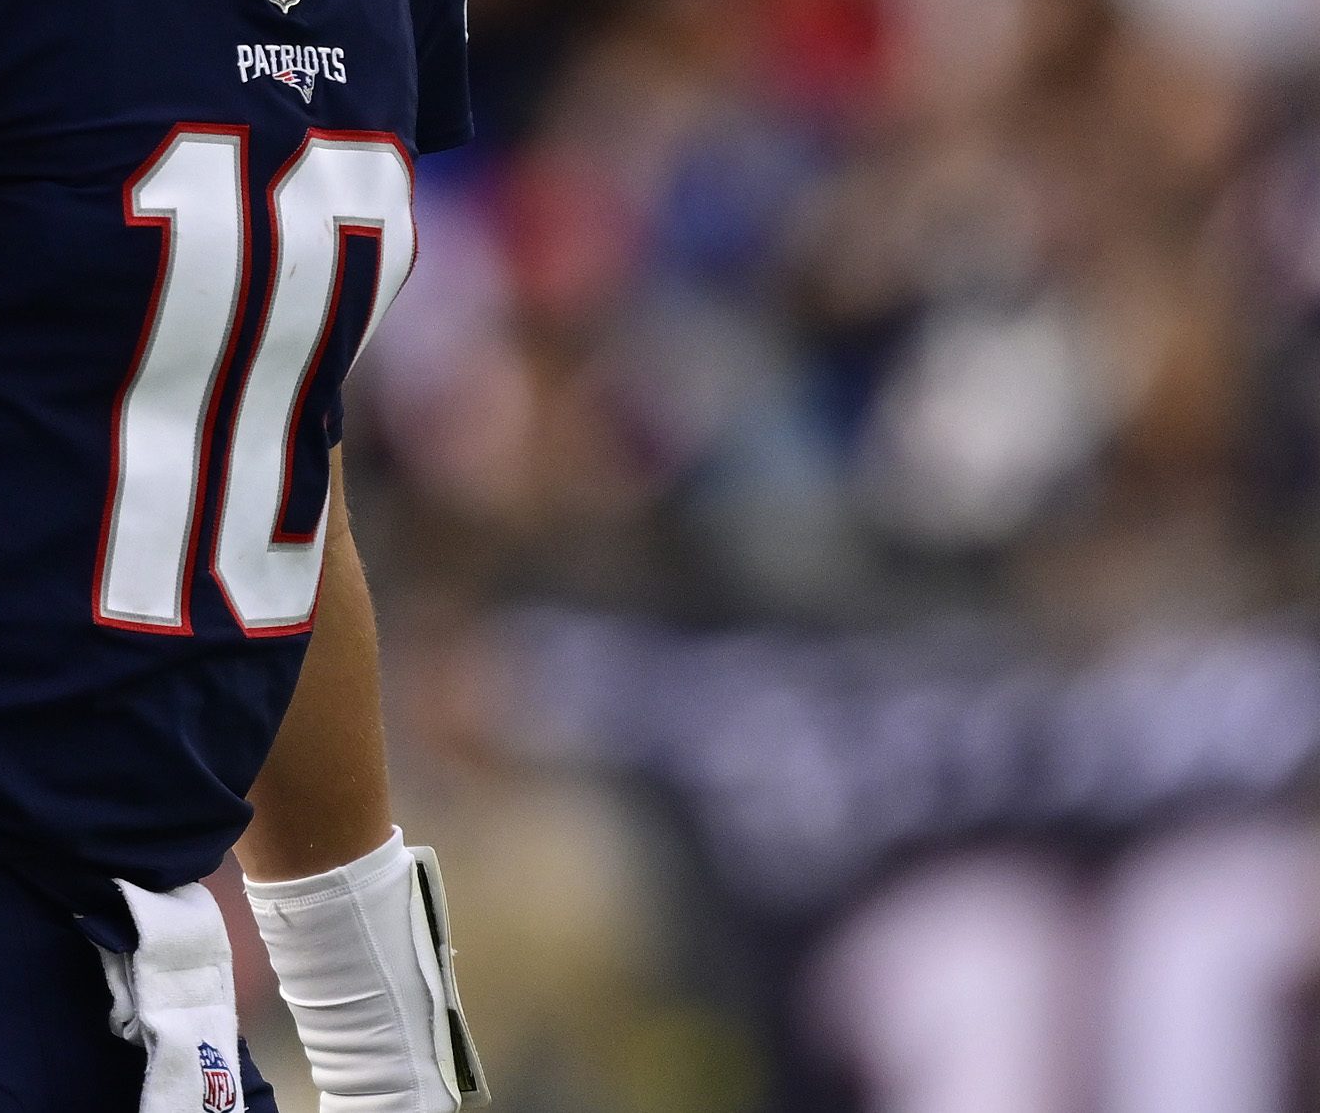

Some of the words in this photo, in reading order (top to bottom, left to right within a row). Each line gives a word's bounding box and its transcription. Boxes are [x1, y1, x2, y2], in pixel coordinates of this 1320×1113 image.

[237, 44, 347, 84] PATRIOTS
[93, 123, 417, 637] 10
[205, 1071, 235, 1111] NFL
